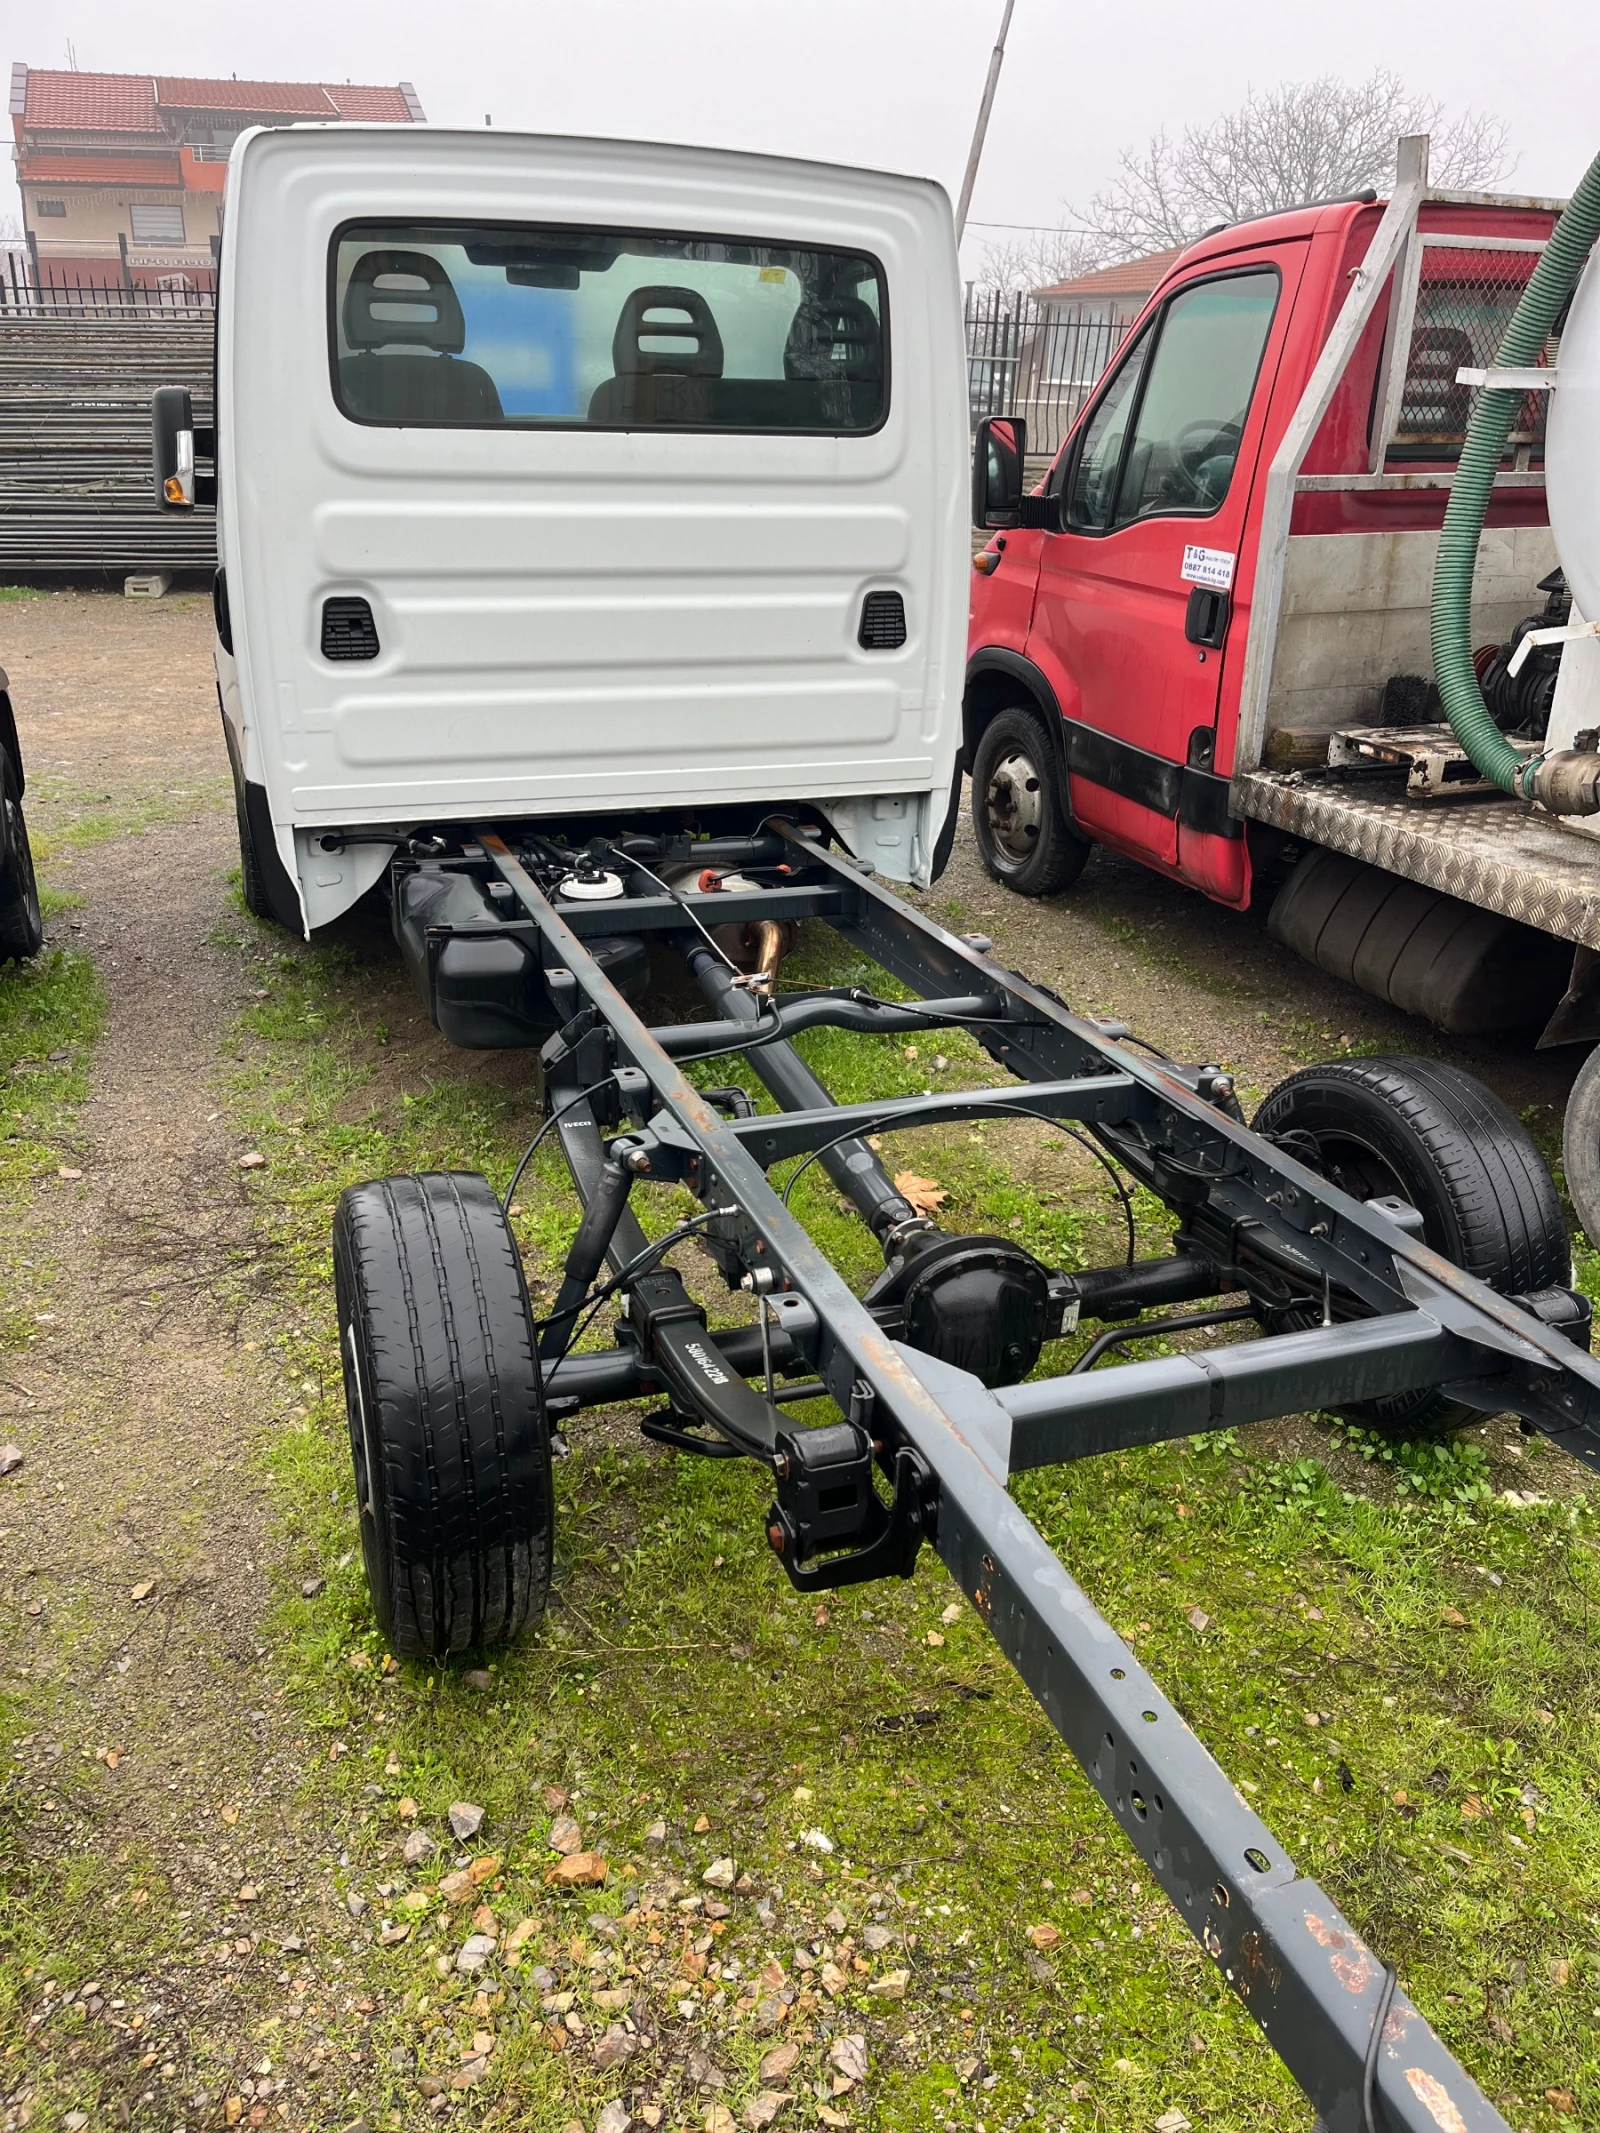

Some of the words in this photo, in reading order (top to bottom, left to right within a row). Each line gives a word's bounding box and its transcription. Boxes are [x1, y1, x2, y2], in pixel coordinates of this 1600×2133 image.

[1184, 562, 1201, 572] 0887
[1203, 566, 1216, 575] 814
[1217, 569, 1230, 578] 418
